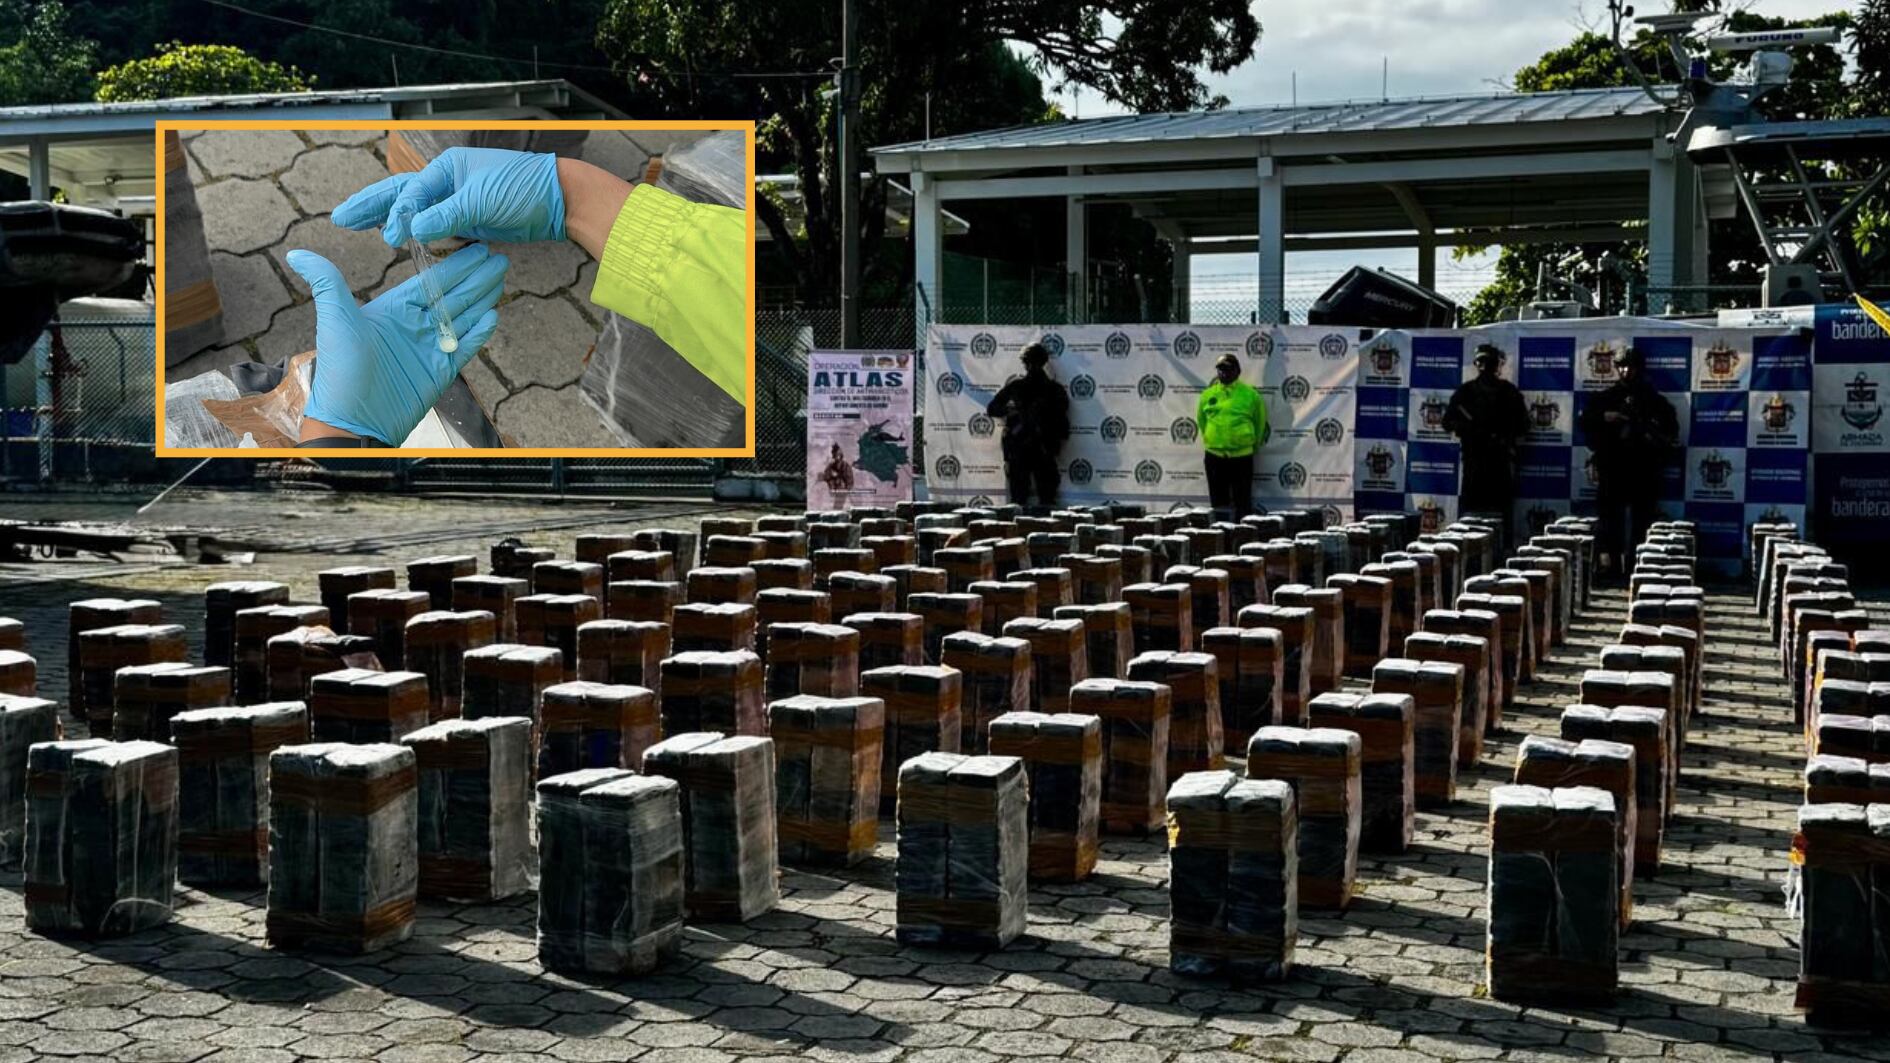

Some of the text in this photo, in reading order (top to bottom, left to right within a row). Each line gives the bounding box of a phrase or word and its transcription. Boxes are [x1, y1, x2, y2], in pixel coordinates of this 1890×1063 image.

[1735, 32, 1804, 43] FURUNO
[814, 371, 903, 387] ATLAS
[1840, 432, 1884, 441] ARMADA
